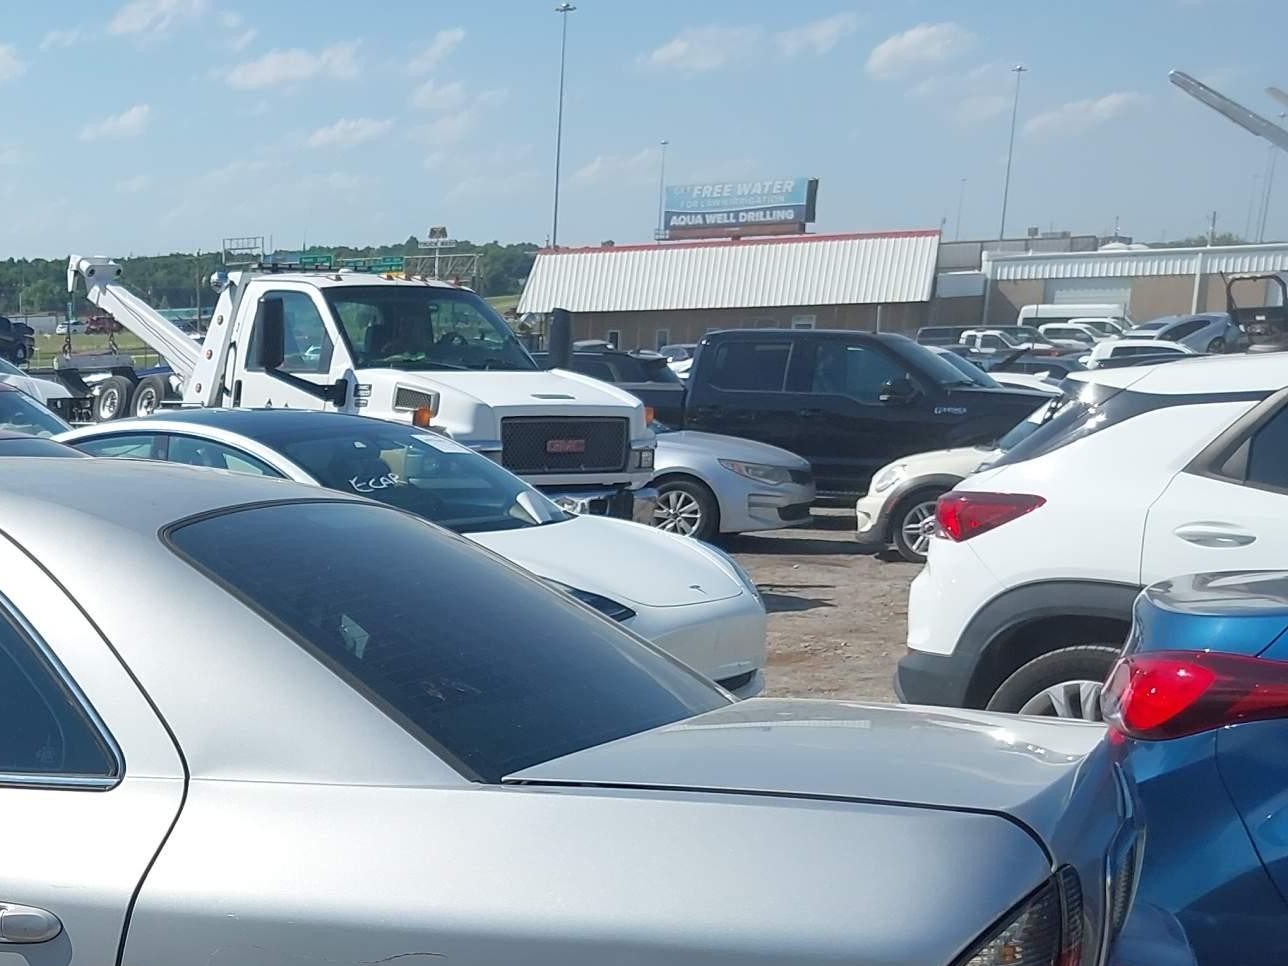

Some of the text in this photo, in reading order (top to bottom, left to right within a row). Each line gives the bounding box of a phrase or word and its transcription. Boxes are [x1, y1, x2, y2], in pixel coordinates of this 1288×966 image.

[693, 184, 732, 198] FREE
[736, 180, 794, 196] WATER
[670, 209, 794, 226] AQUA WELL DRILLING
